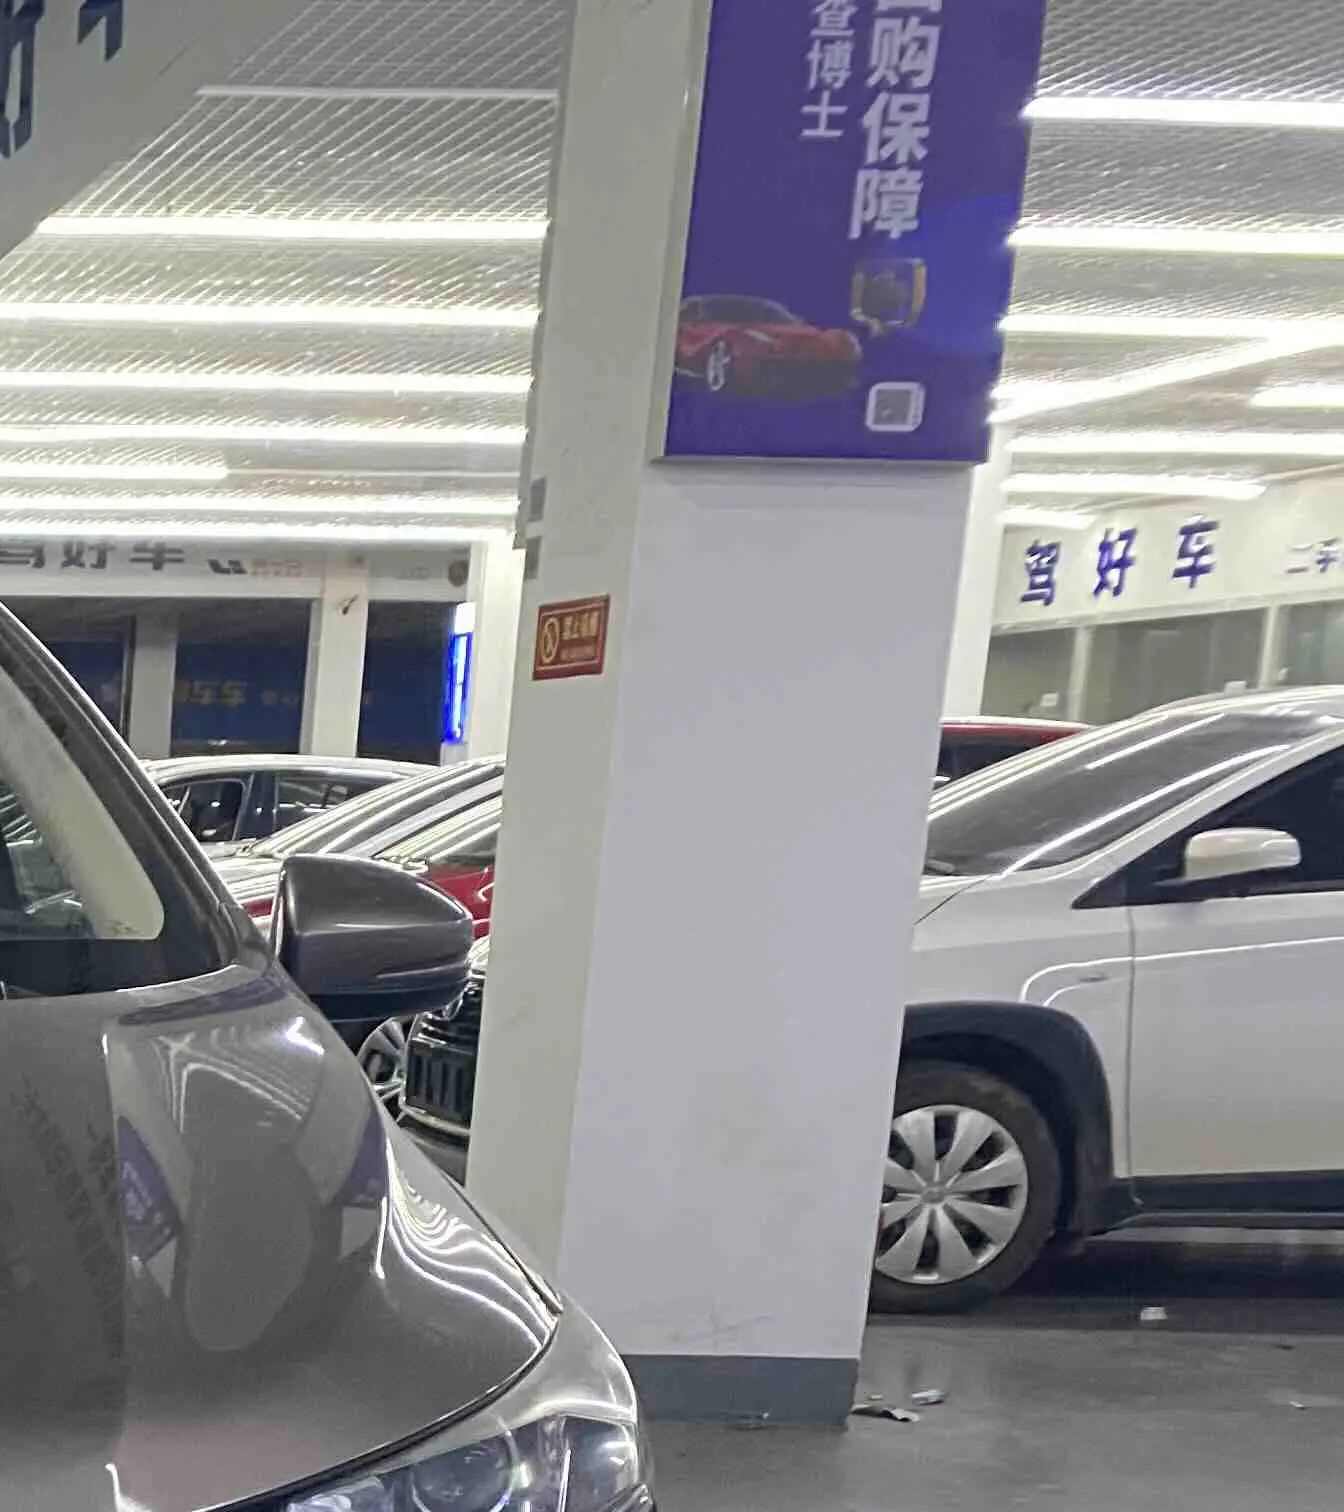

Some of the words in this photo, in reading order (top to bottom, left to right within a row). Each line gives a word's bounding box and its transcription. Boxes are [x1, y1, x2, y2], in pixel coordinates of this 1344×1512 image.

[800, 0, 859, 138] 查博士
[847, 0, 943, 241] 购保障
[1019, 512, 1220, 607] 驾好车
[1285, 536, 1344, 575] 二手
